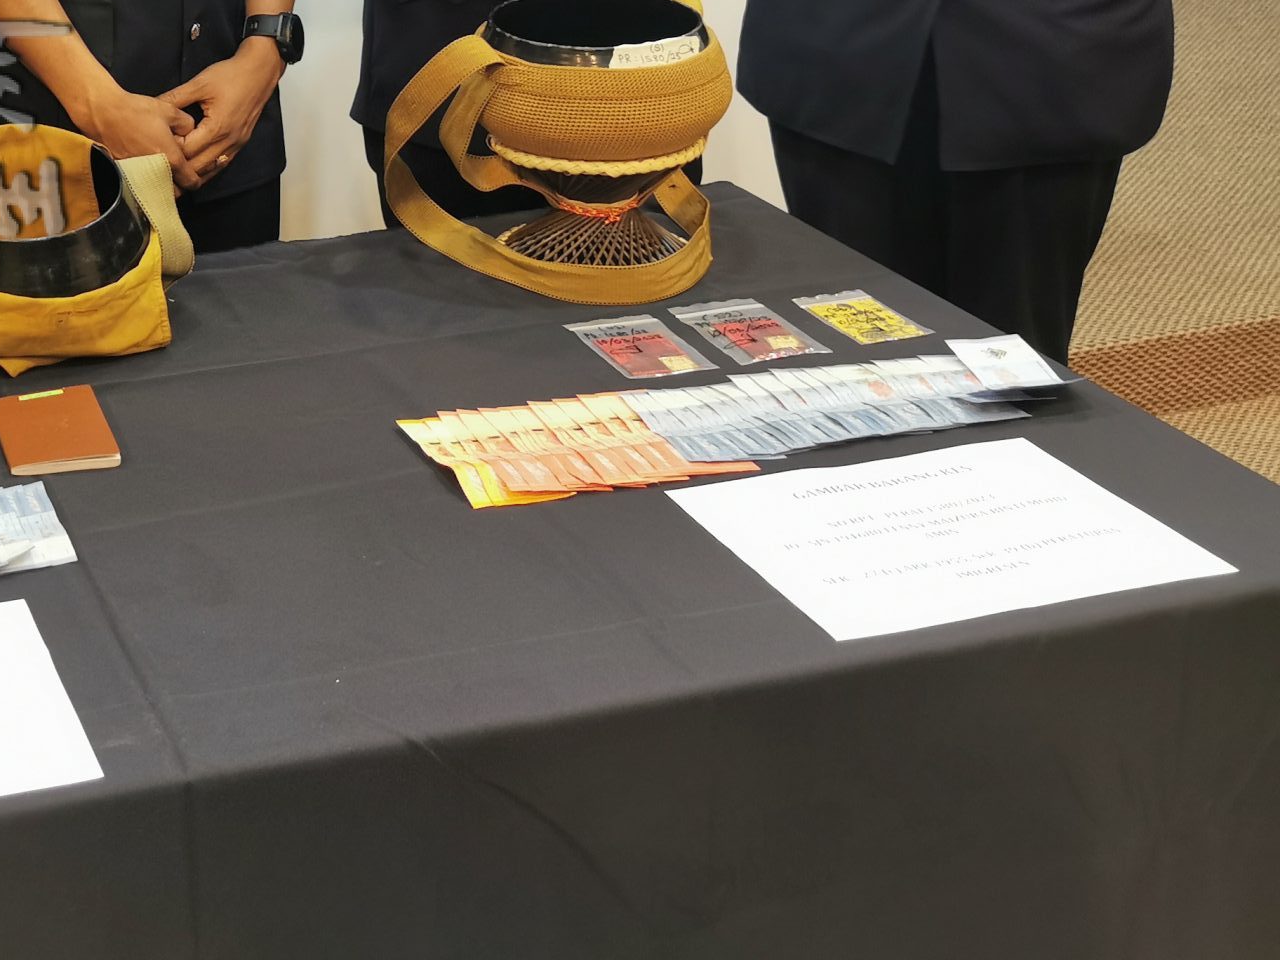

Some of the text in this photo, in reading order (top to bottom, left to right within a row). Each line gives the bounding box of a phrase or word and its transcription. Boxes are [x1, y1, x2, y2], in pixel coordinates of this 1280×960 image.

[791, 464, 972, 499] GAMBAR BARANG KES
